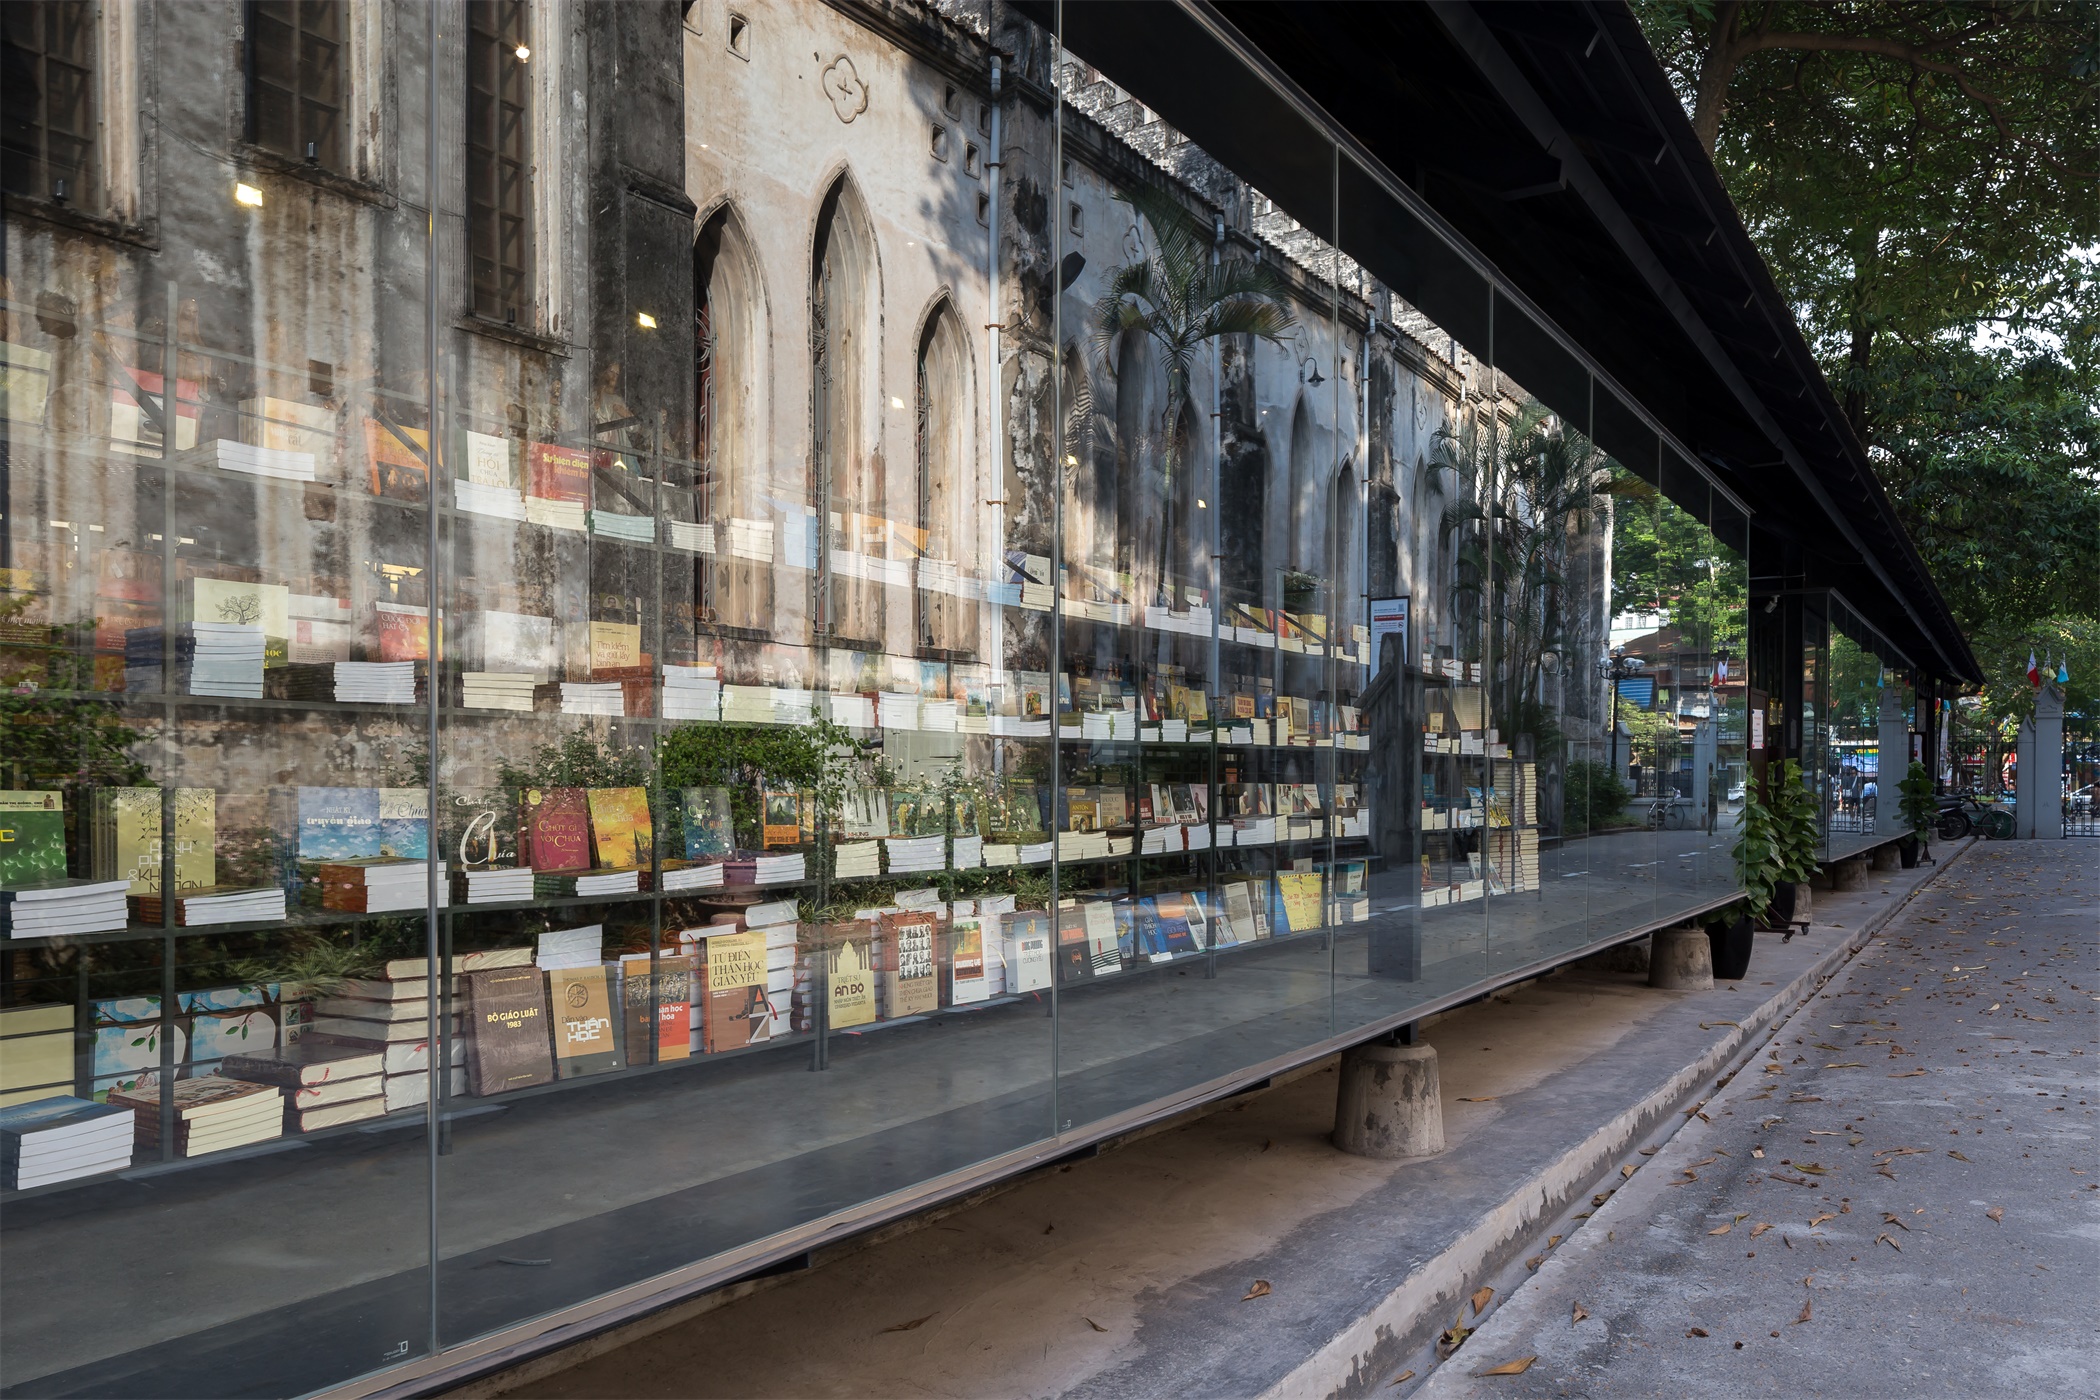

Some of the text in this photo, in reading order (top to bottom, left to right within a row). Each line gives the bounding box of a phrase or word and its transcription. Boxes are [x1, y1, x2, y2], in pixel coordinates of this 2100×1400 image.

[477, 453, 500, 470] HỎI
[150, 841, 193, 854] HNH
[138, 868, 182, 882] KHN
[712, 949, 751, 964] TỪ ĐIỂN
[712, 960, 764, 976] THẦN HỌC
[740, 971, 760, 984] YẾU
[837, 974, 853, 984] TRIẾT
[834, 982, 865, 997] ẤN ĐỘ
[487, 1007, 539, 1023] BỘ GIÁO LUẬT
[507, 1020, 522, 1029] 1983
[567, 1029, 601, 1043] HỌC
